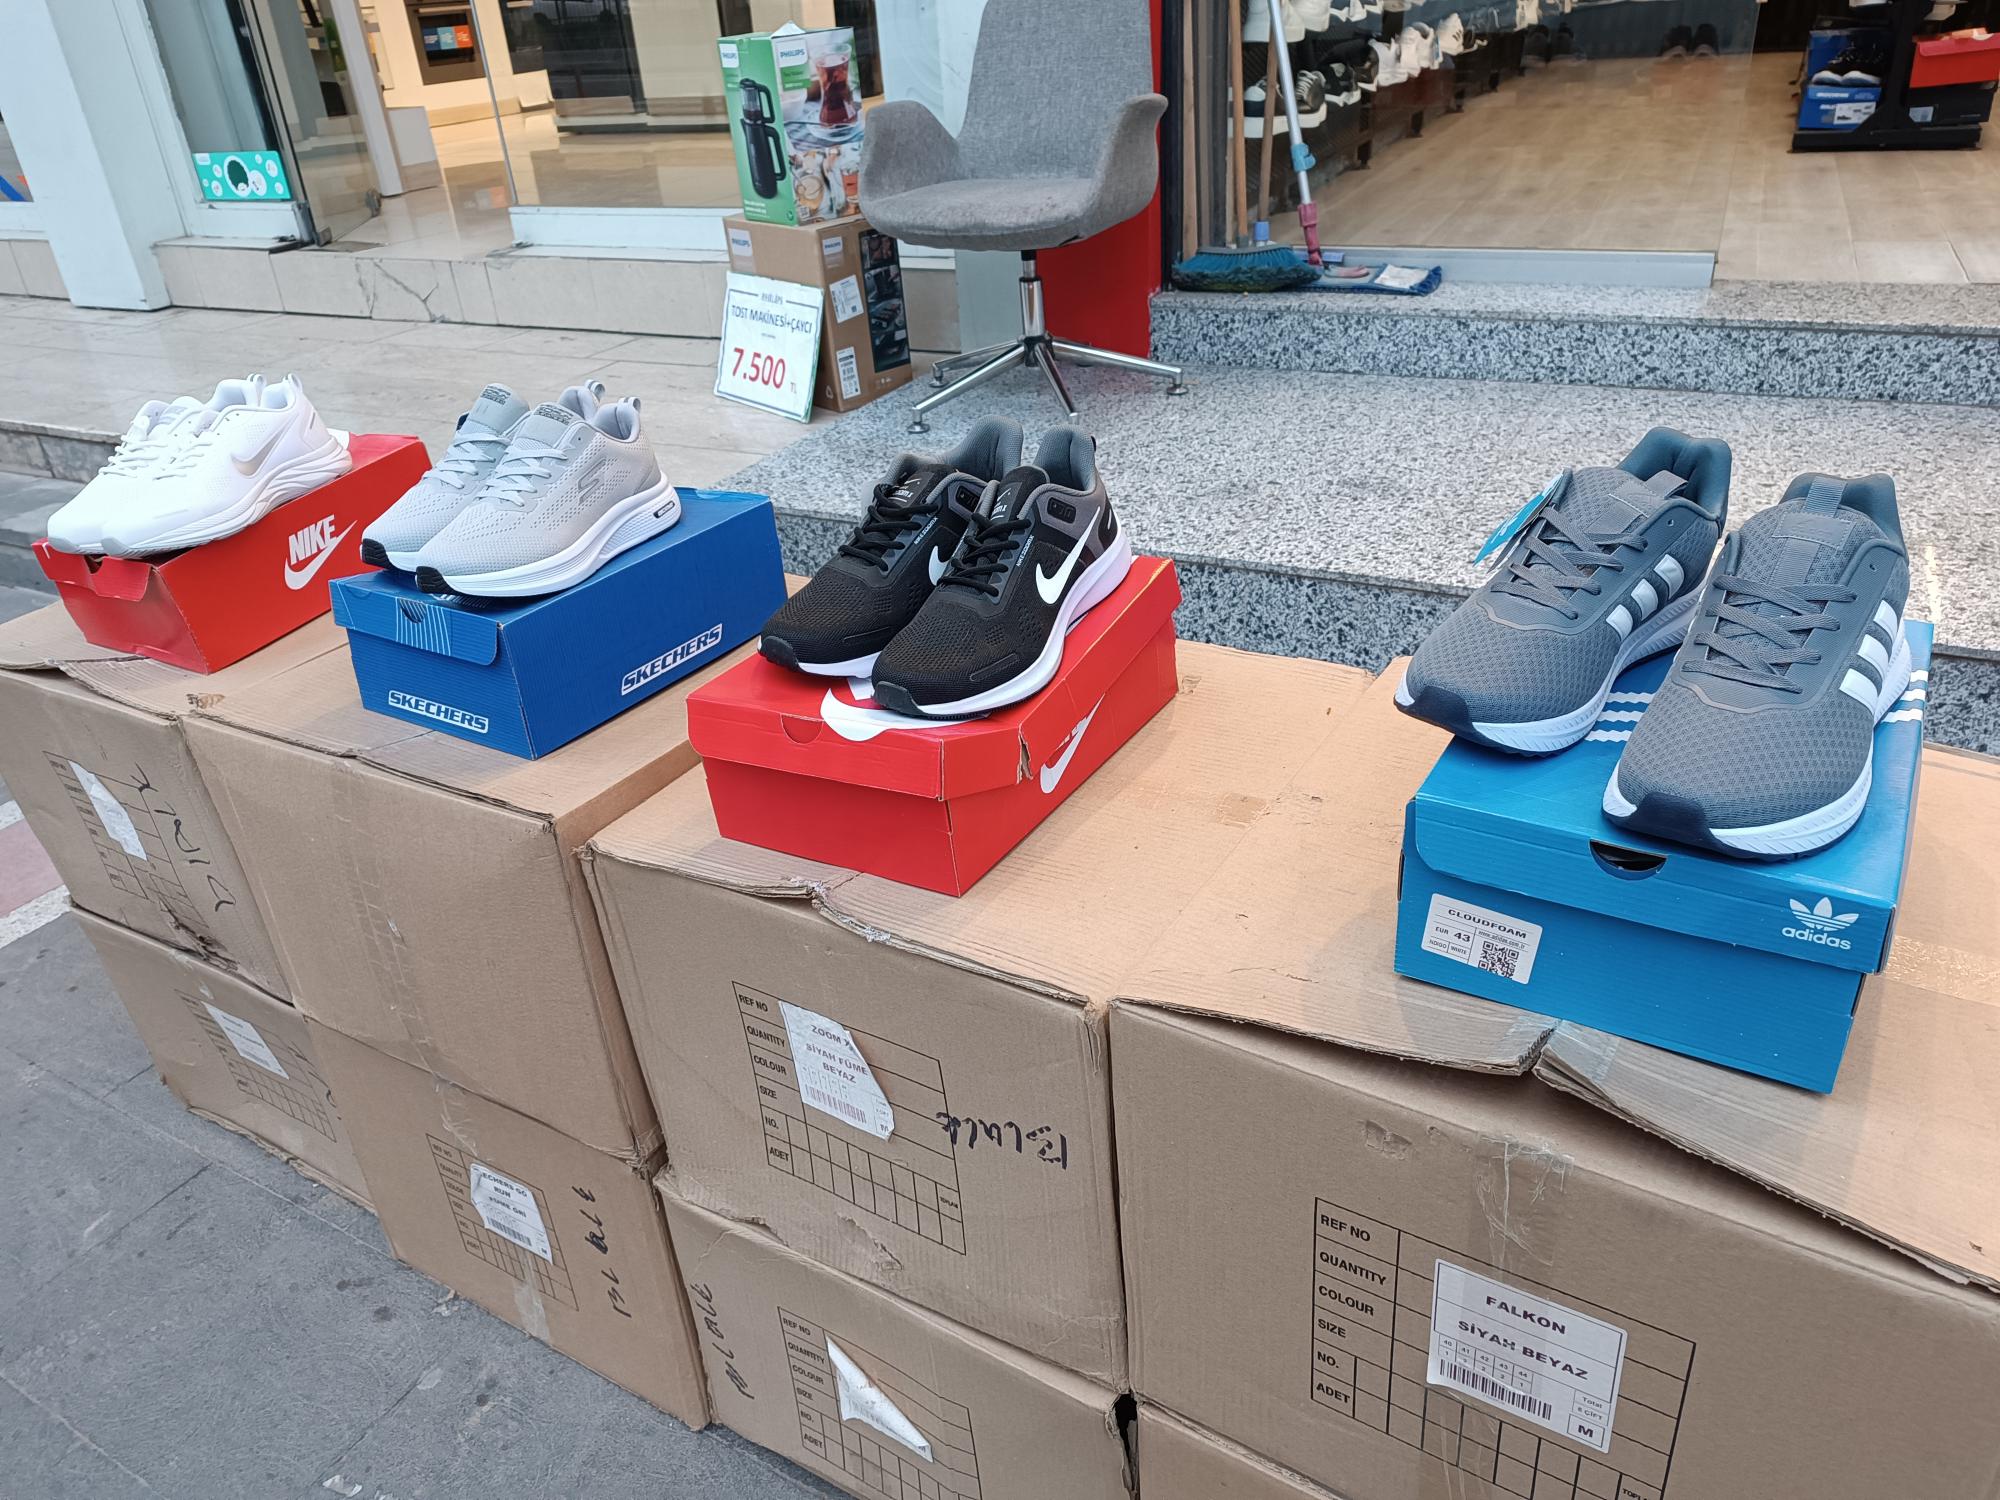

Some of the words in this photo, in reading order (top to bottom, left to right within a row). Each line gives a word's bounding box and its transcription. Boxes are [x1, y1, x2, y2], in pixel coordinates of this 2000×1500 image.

[732, 305, 748, 319] TOST
[732, 347, 786, 389] 7.500
[288, 514, 337, 567] NIKE
[622, 623, 722, 694] SKECHERS
[389, 692, 488, 732] SKECHERS
[1448, 908, 1527, 939] CLOUDFOAM
[1454, 931, 1471, 943] 43
[1781, 927, 1852, 950] adidas
[738, 994, 755, 1008] REF
[755, 1000, 769, 1013] NO
[746, 1026, 786, 1047] QUANTITY
[811, 1025, 841, 1045] ZOOM
[805, 1042, 836, 1062] SİYAH
[753, 1054, 787, 1076] COLOUR
[823, 1062, 857, 1083] BEYAZ
[759, 1085, 778, 1100] SIZE
[765, 1116, 779, 1130] NO.
[769, 1147, 790, 1162] ADET
[1320, 1214, 1348, 1233] REF
[1350, 1225, 1371, 1242] NO
[1319, 1250, 1387, 1286] QUANTITY
[1318, 1285, 1374, 1316] COLOUR
[1486, 1295, 1566, 1335] FALKON
[1317, 1318, 1347, 1338] SIZE
[788, 1341, 826, 1365] QUANTITY
[1317, 1351, 1339, 1369] NO.
[1458, 1319, 1516, 1351] SİYAH
[1522, 1337, 1589, 1380] BEYAZ
[792, 1364, 824, 1385] COLOUR
[796, 1387, 813, 1401] SIZE
[1316, 1382, 1351, 1404] ADET
[803, 1433, 823, 1449] ADET
[1577, 1424, 1594, 1438] M
